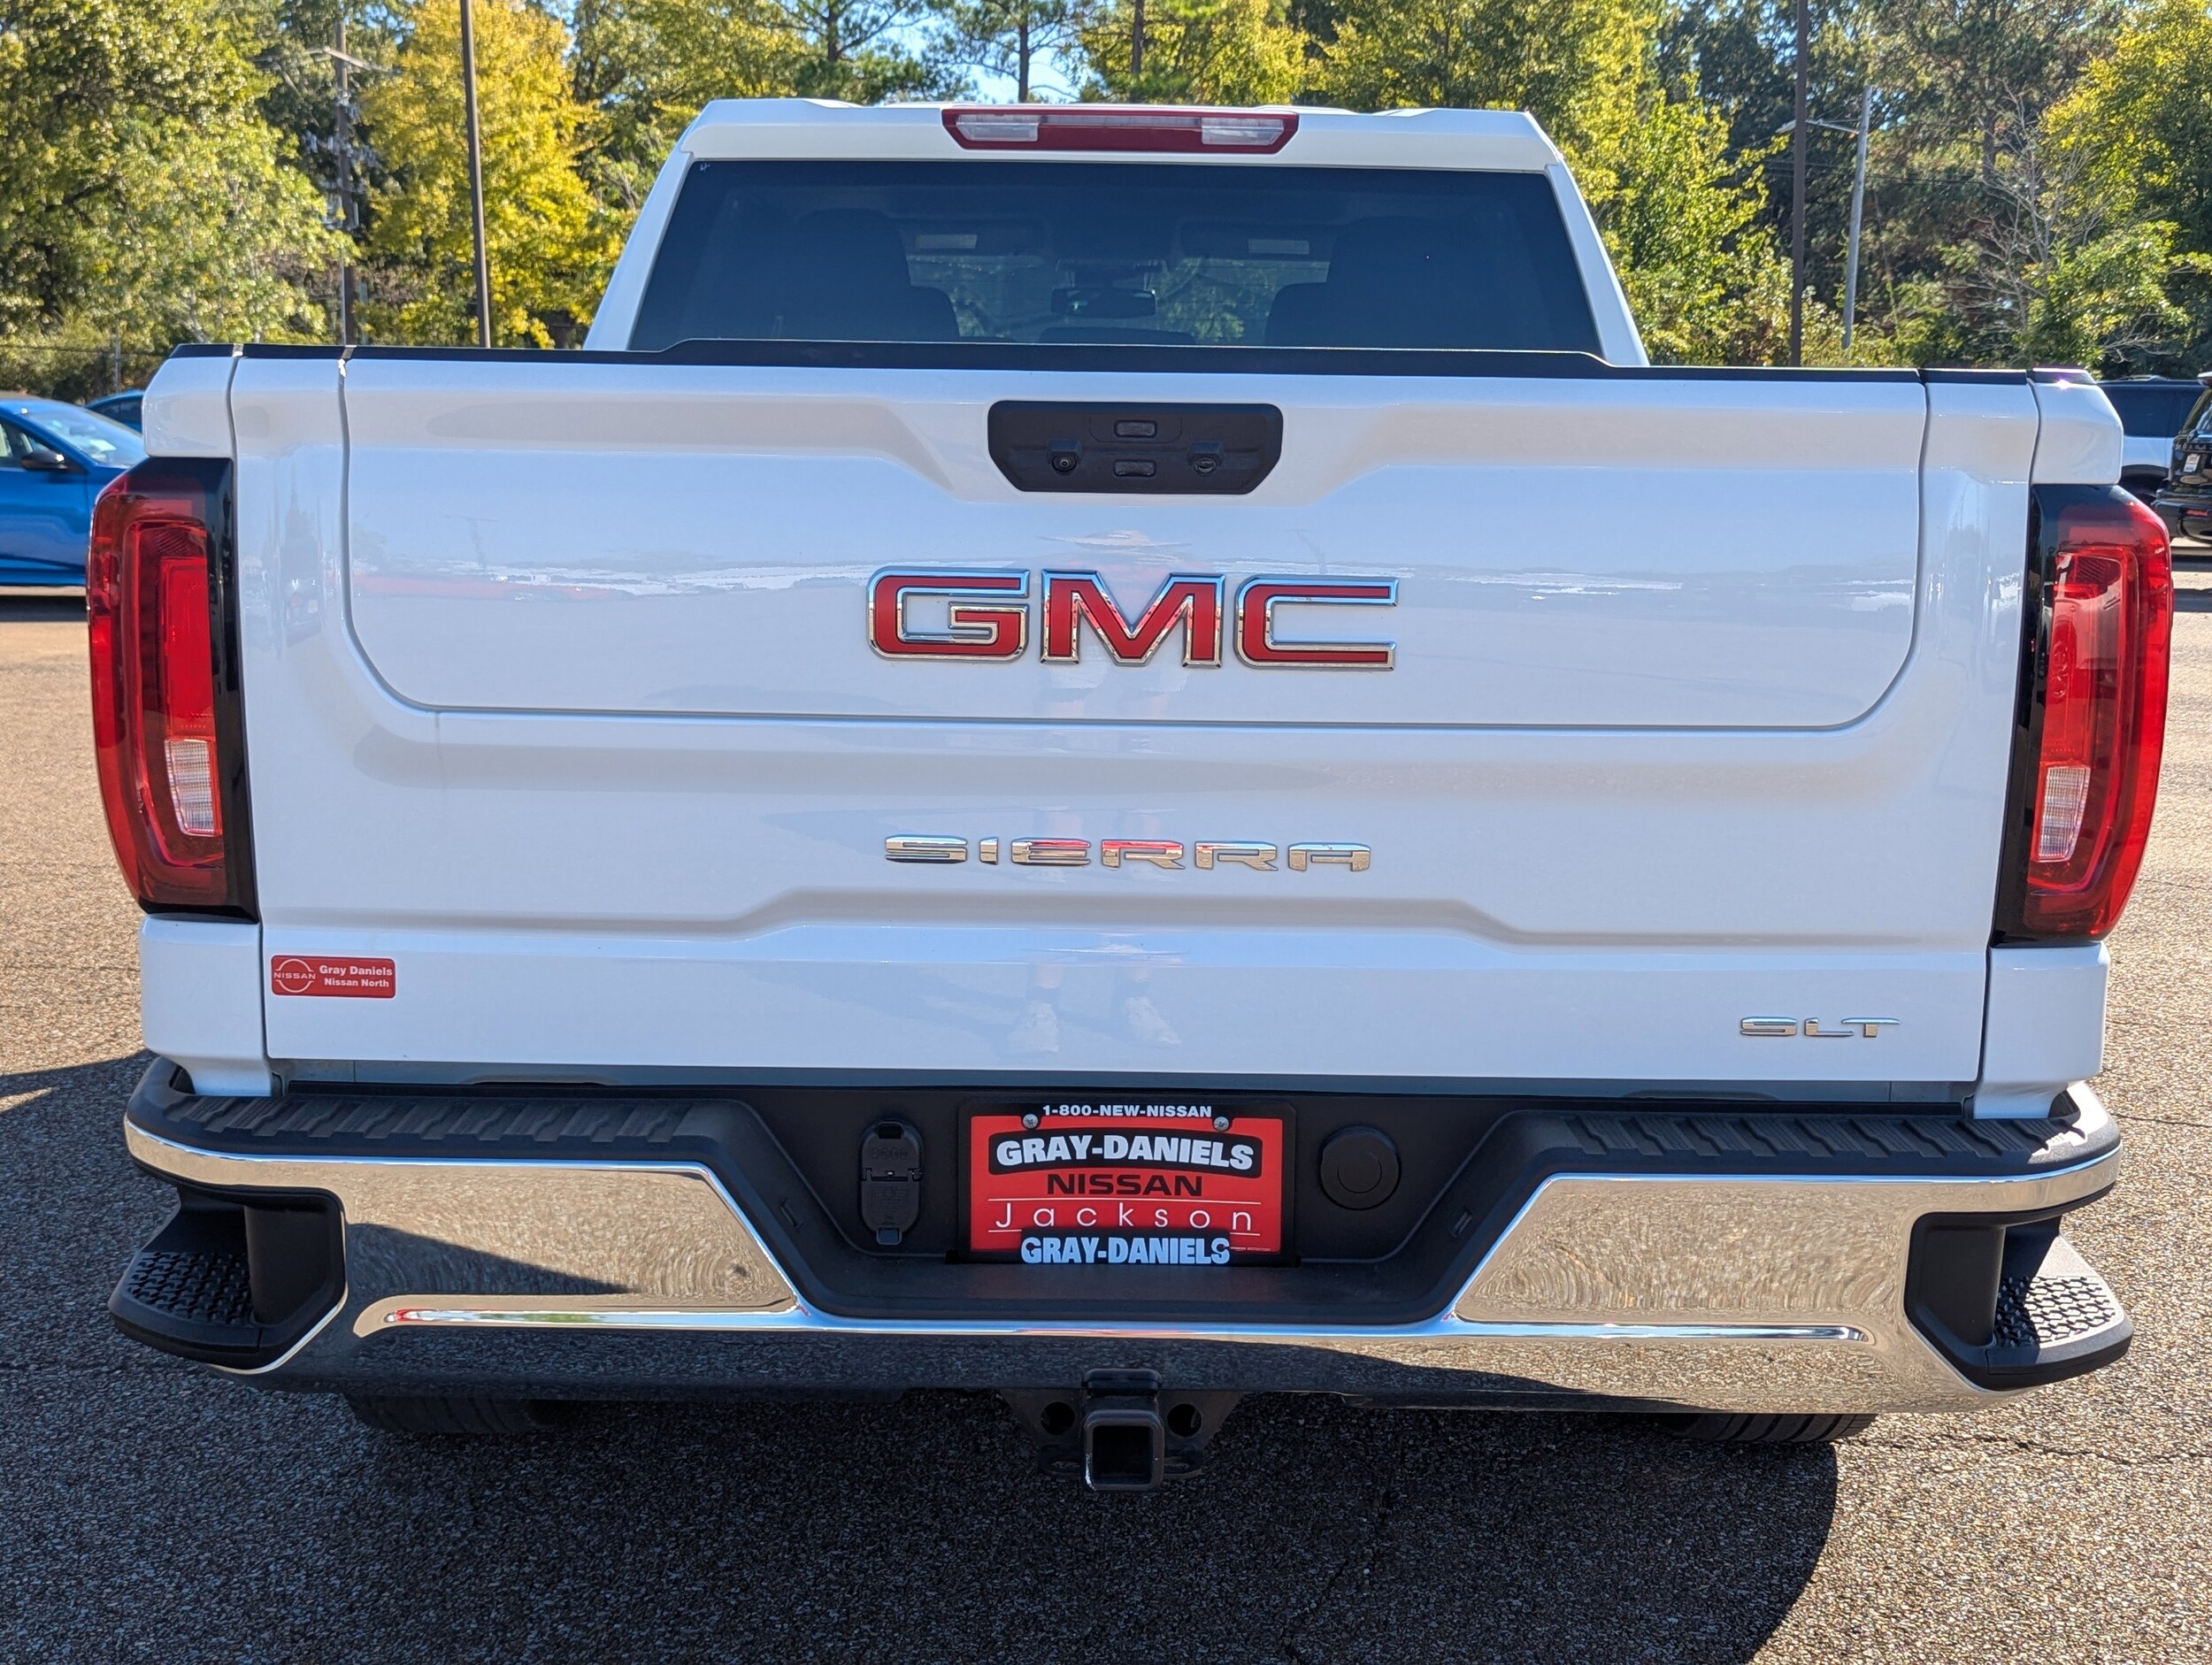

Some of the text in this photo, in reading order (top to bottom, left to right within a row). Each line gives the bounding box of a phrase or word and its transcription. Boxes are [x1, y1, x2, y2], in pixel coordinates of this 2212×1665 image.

[868, 566, 1399, 671] GMC
[885, 835, 1371, 871] SIERRA
[319, 964, 393, 977] Gray Daniels
[324, 978, 389, 987] Nissan North
[1740, 1017, 1901, 1038] SLT
[1042, 1104, 1212, 1117] 1-800-NEW-NISSAN
[996, 1134, 1254, 1170] GRAY-DANIELS
[1048, 1174, 1202, 1196] NISSAN
[995, 1201, 1252, 1231] Jackson
[1020, 1237, 1231, 1265] GRAY-DANIELS
